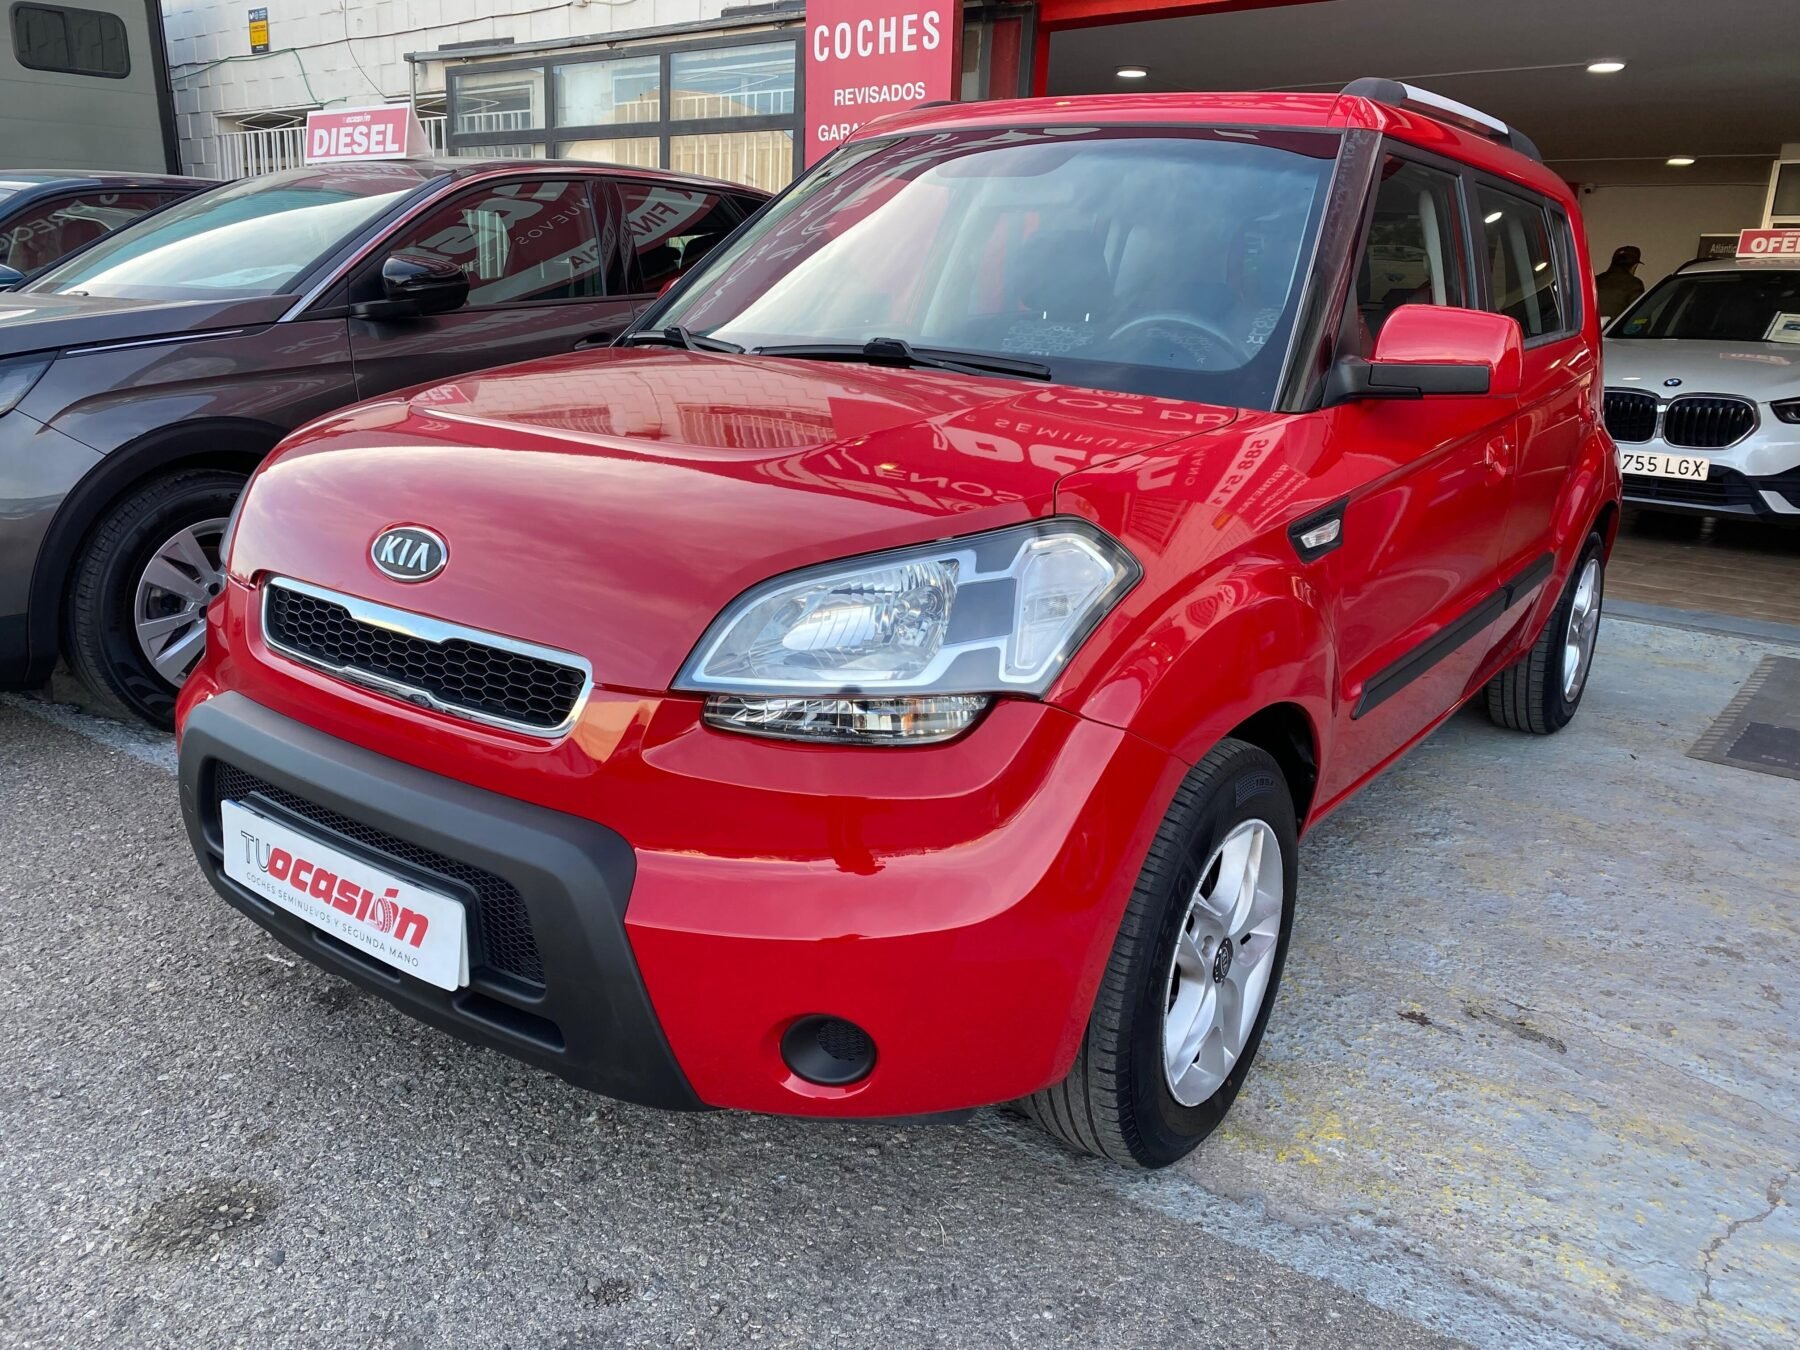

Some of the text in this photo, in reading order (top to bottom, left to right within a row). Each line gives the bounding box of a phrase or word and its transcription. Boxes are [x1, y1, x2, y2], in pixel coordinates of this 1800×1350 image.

[813, 10, 940, 62] COCHES
[834, 81, 926, 106] REVISADOS
[312, 123, 399, 156] DIESEL
[817, 122, 864, 142] GARA
[1622, 454, 1704, 477] 755 LGX
[380, 535, 430, 572] KIA
[246, 871, 276, 895] COCHES
[278, 884, 331, 925] SEMINUEVOS
[342, 922, 386, 953] SEGUNDA
[389, 946, 419, 968] MANO
